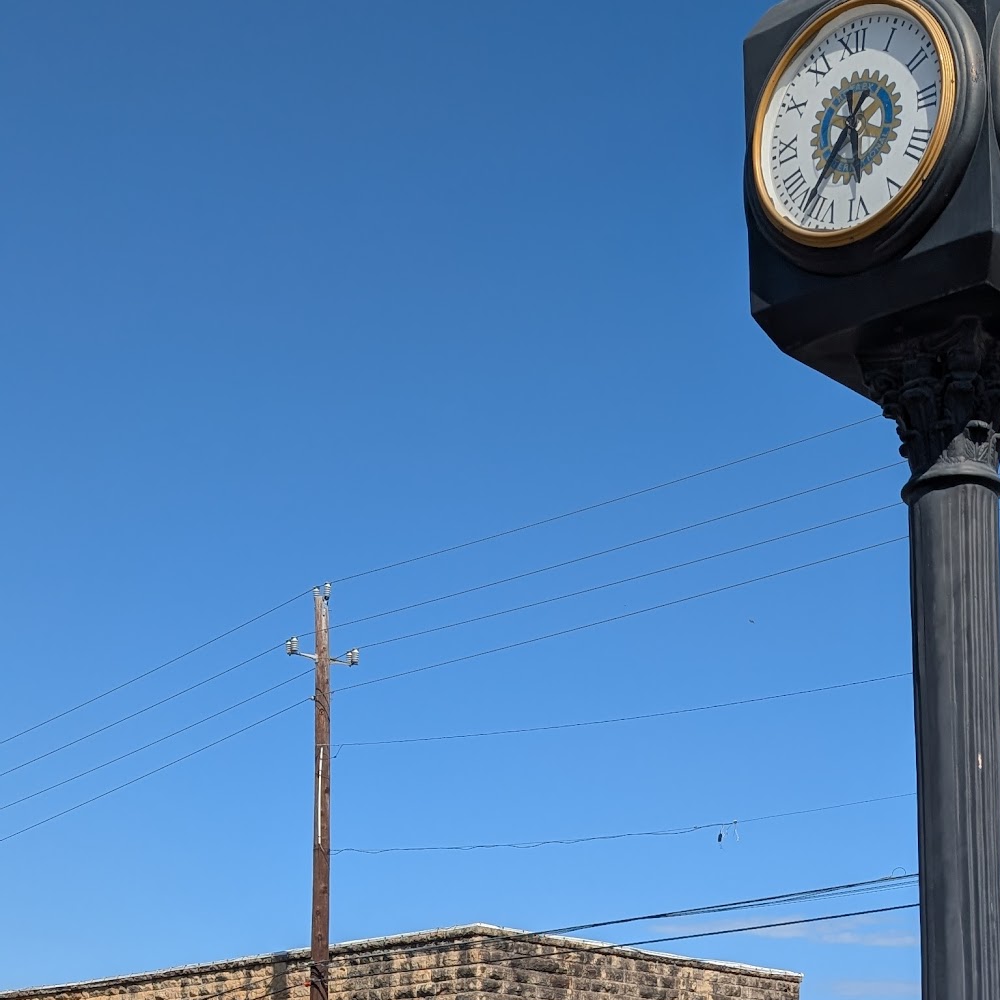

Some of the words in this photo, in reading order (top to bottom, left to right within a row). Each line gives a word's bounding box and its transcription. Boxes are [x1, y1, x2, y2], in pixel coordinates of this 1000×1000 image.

[838, 27, 868, 62] XII
[883, 28, 897, 52] I
[806, 52, 833, 87] XI
[906, 47, 928, 75] II
[786, 95, 808, 118] X
[916, 81, 937, 112] III
[779, 134, 798, 167] IX
[903, 126, 932, 163] IIII
[848, 195, 870, 222] VI
